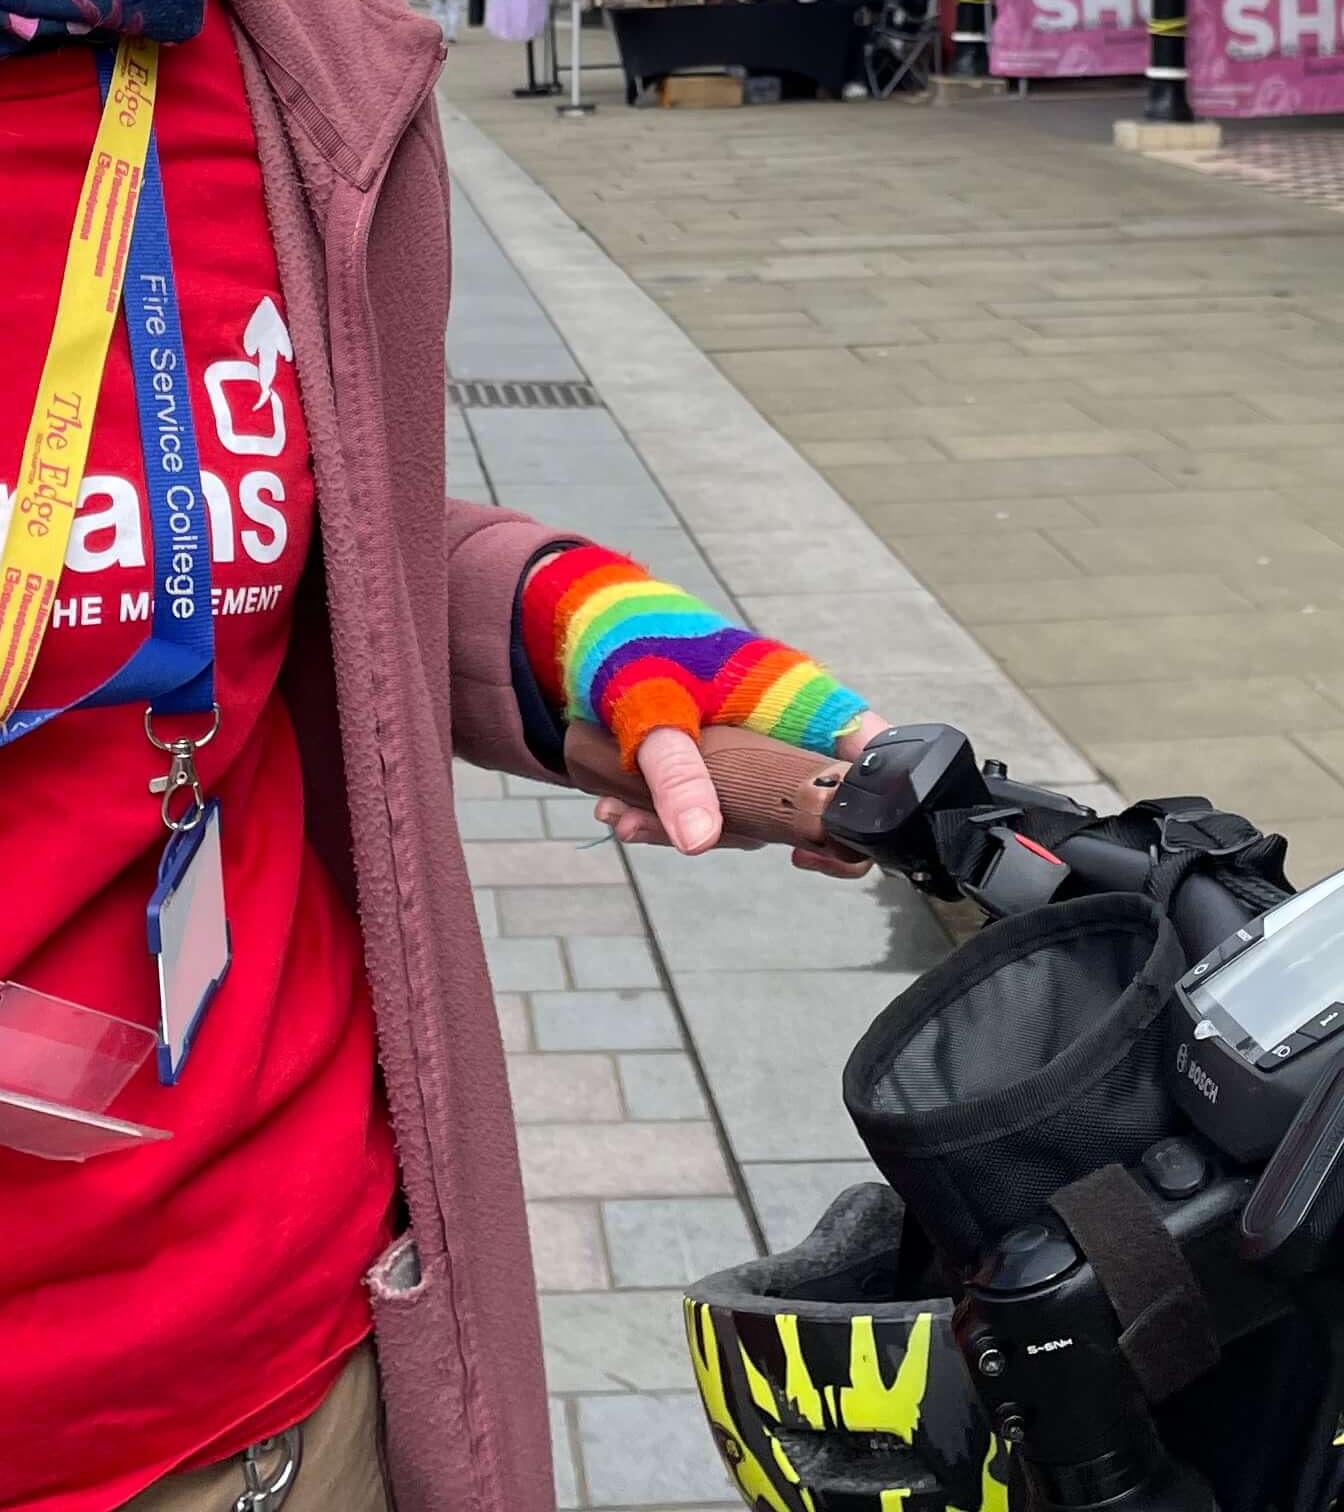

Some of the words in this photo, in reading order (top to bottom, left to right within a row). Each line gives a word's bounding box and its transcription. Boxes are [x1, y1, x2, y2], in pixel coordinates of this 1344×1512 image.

[114, 57, 153, 128] Edge
[139, 274, 169, 337] Fire
[46, 391, 83, 451] The
[150, 347, 185, 474] Service
[20, 458, 74, 537] Edge
[164, 485, 199, 621] College
[52, 596, 103, 629] HE
[119, 584, 283, 623] MEMENT
[1187, 1063, 1219, 1105] BOSCH
